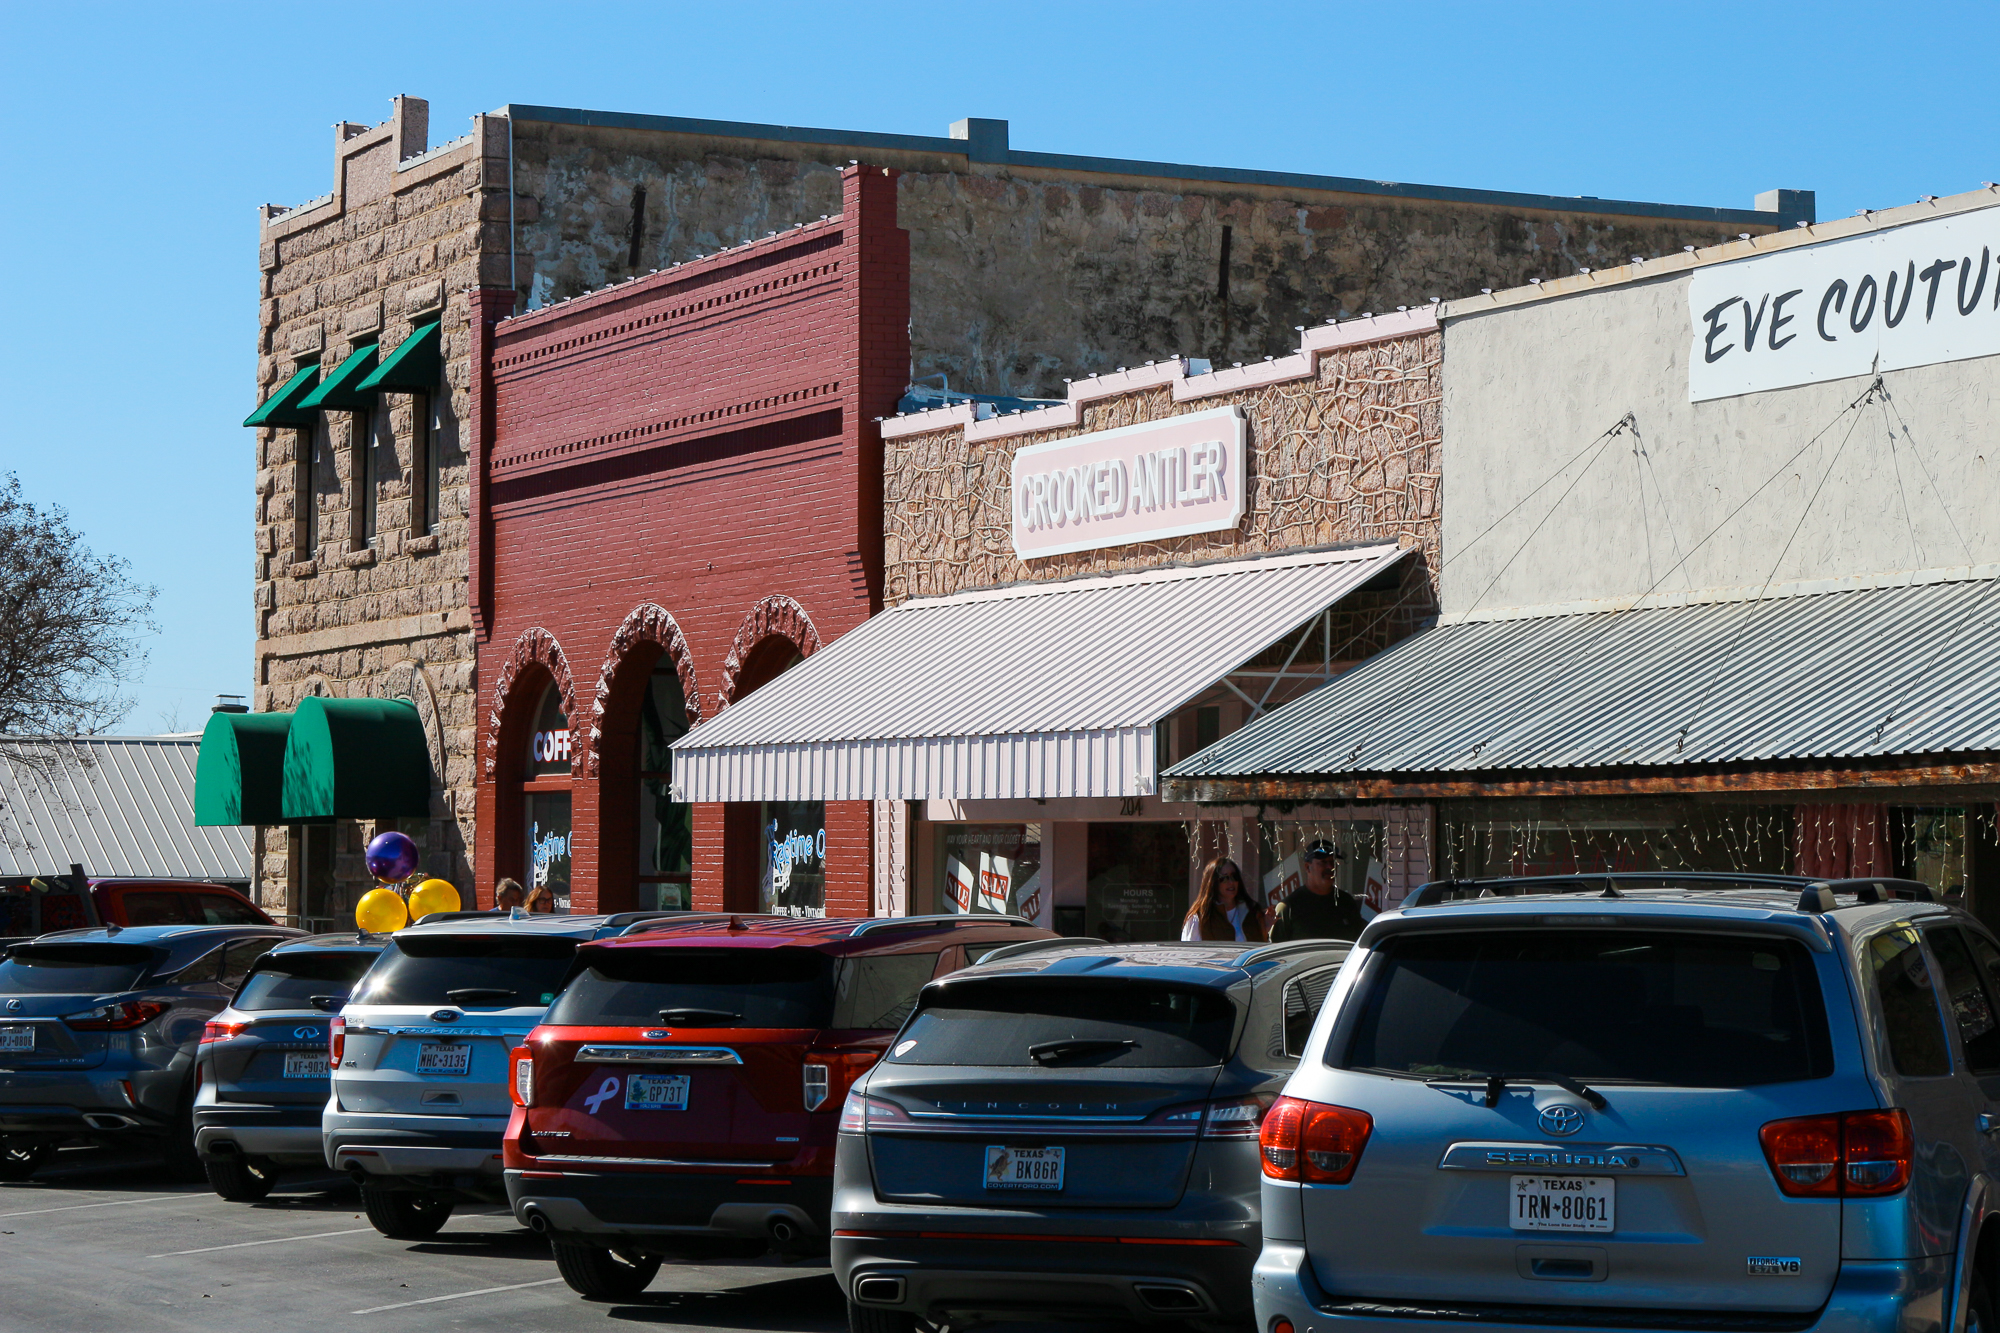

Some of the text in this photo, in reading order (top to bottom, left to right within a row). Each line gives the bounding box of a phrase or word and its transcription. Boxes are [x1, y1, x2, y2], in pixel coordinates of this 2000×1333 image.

[1703, 288, 1803, 364] EVE
[1019, 441, 1227, 530] CROOKED ANTLER
[1120, 798, 1142, 816] 204
[772, 829, 814, 874] Ragtime
[946, 876, 969, 907] SALE
[981, 874, 1008, 896] SALE
[1123, 889, 1154, 897] HOURS
[649, 1086, 683, 1103] GP73T
[936, 1101, 1118, 1110] LINCOLN
[1014, 1150, 1044, 1158] TEXAS
[1486, 1152, 1629, 1169] SEQUOIA
[1016, 1161, 1058, 1180] BK86R
[986, 1182, 1060, 1190] COVERTFORD.COM
[1543, 1180, 1583, 1192] TEXAS
[1780, 1261, 1799, 1273] V8
